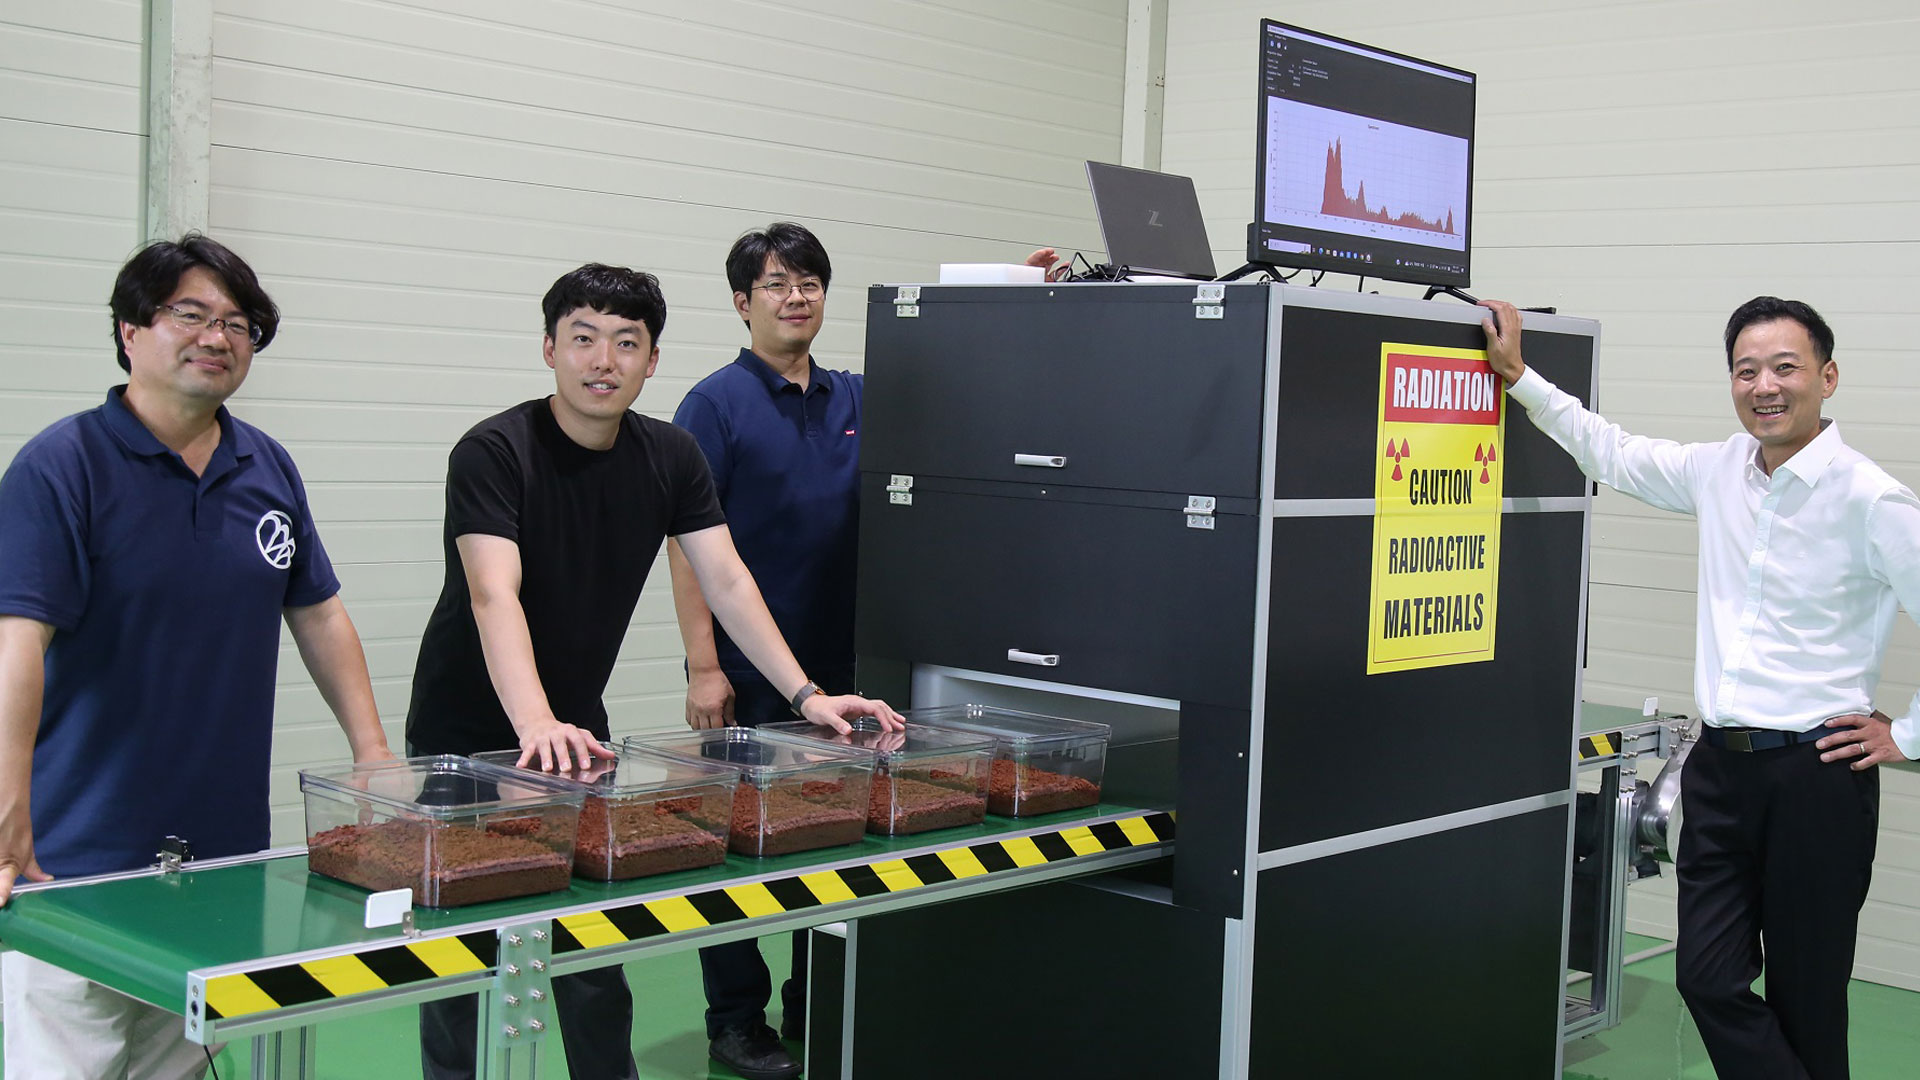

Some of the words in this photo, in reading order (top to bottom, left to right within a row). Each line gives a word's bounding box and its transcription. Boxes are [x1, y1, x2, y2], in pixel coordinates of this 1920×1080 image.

[1392, 366, 1495, 412] RADIATION
[1409, 468, 1472, 505] CAUTION
[1388, 534, 1485, 574] RADIOACTIVE
[1383, 593, 1484, 639] MATERIALS
